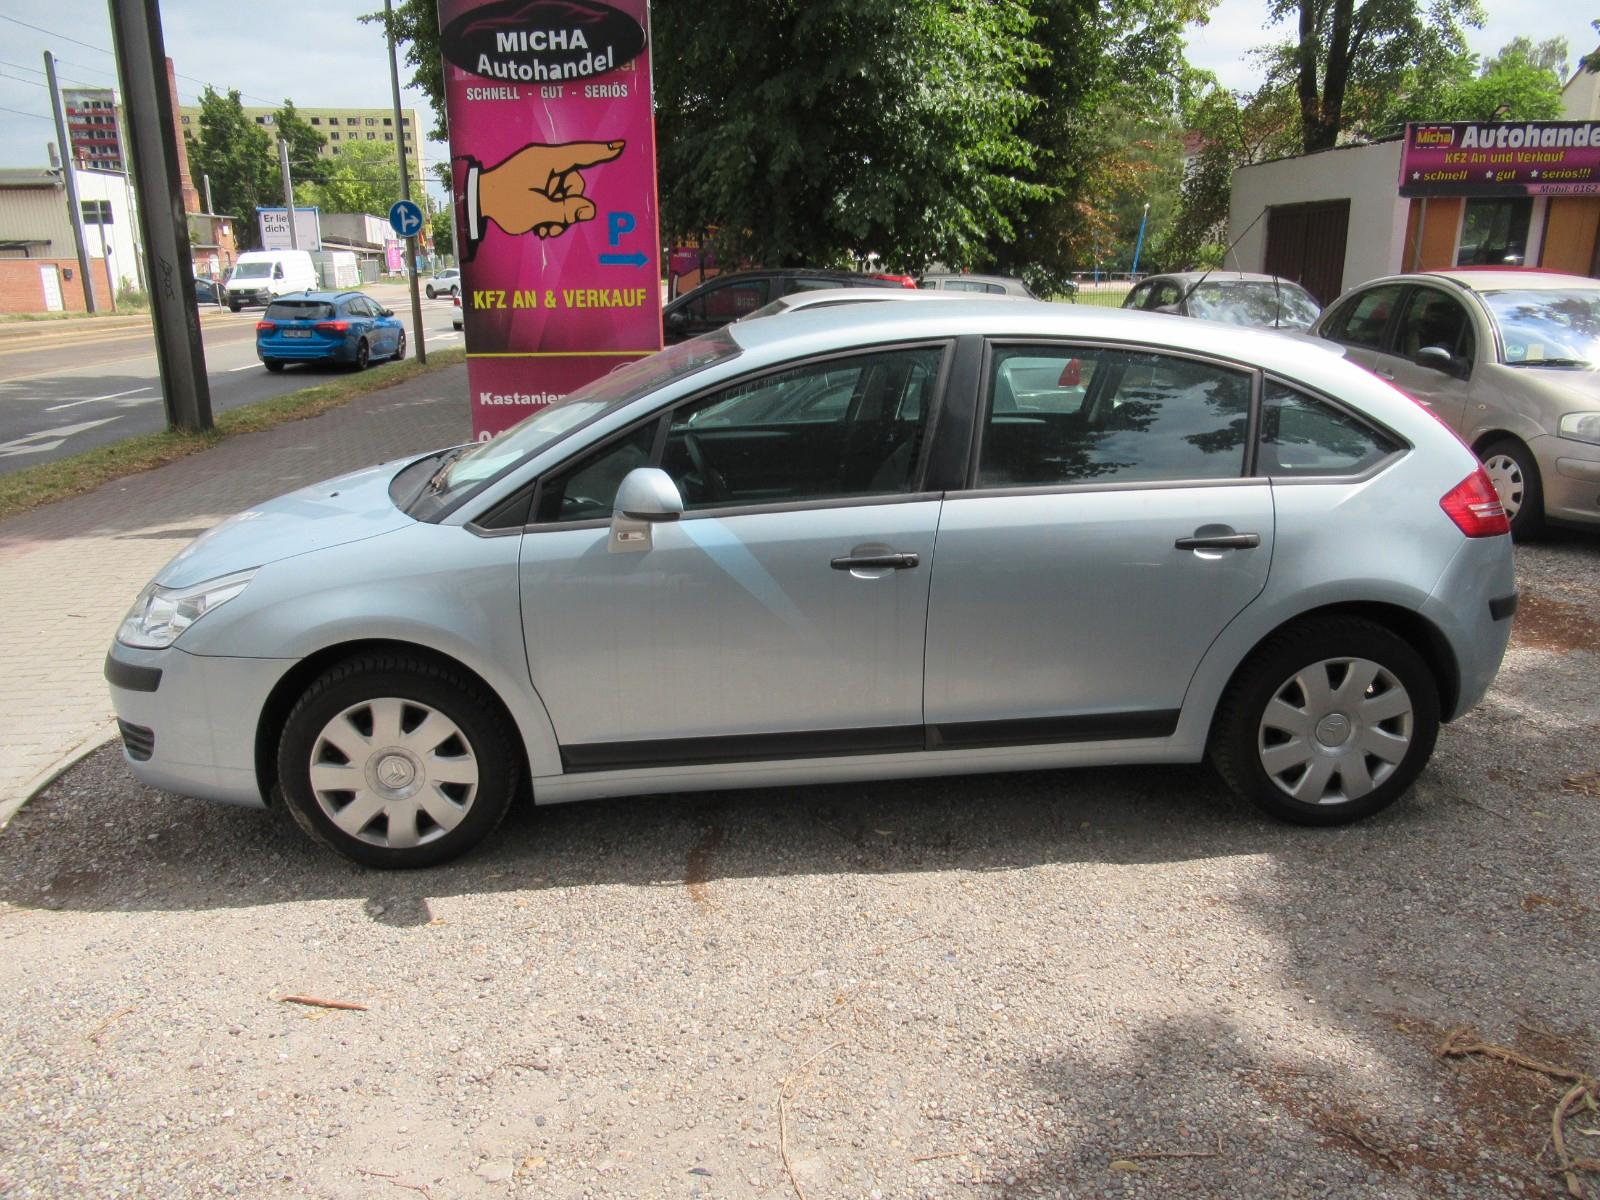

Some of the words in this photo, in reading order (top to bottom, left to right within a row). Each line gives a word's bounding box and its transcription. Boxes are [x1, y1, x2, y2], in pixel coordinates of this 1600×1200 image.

[496, 29, 588, 53] MICHA
[477, 46, 614, 81] Autohandel
[466, 87, 520, 101] SCHNELL
[540, 86, 564, 99] GUT
[584, 82, 628, 98] SERIÖS
[1417, 130, 1451, 144] Micha
[1445, 152, 1467, 164] KFZ
[1471, 153, 1486, 163] An
[1490, 152, 1513, 163] und
[1517, 151, 1565, 163] Verkauf
[1423, 170, 1468, 181] schnell
[1496, 169, 1516, 182] gut
[265, 224, 286, 233] dich
[608, 211, 636, 246] P
[473, 290, 507, 310] KFZ
[512, 290, 537, 309] AN
[544, 291, 557, 309] &
[563, 288, 647, 309] VERKAUF
